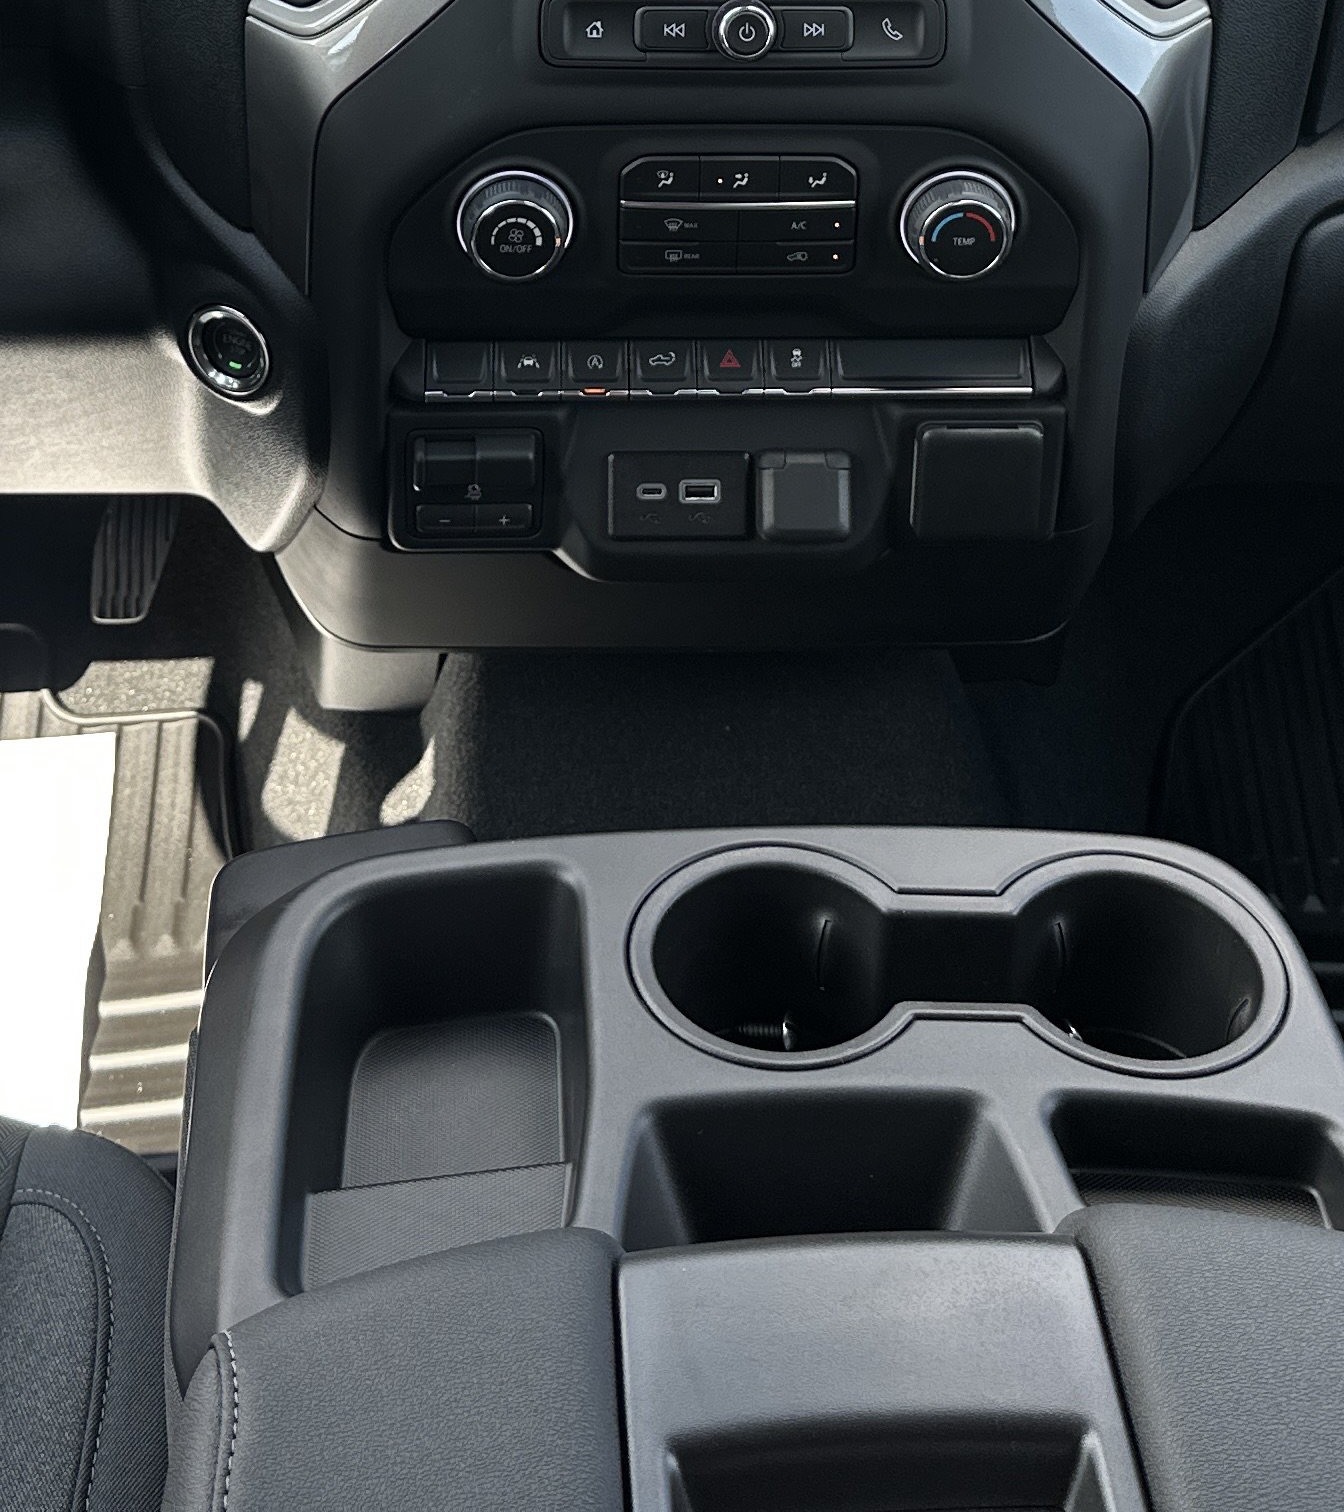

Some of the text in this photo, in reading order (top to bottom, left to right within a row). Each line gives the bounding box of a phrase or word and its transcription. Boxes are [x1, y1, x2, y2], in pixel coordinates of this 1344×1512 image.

[790, 221, 807, 230] A/C
[952, 237, 976, 246] TEMP
[499, 244, 532, 253] ON/OFF
